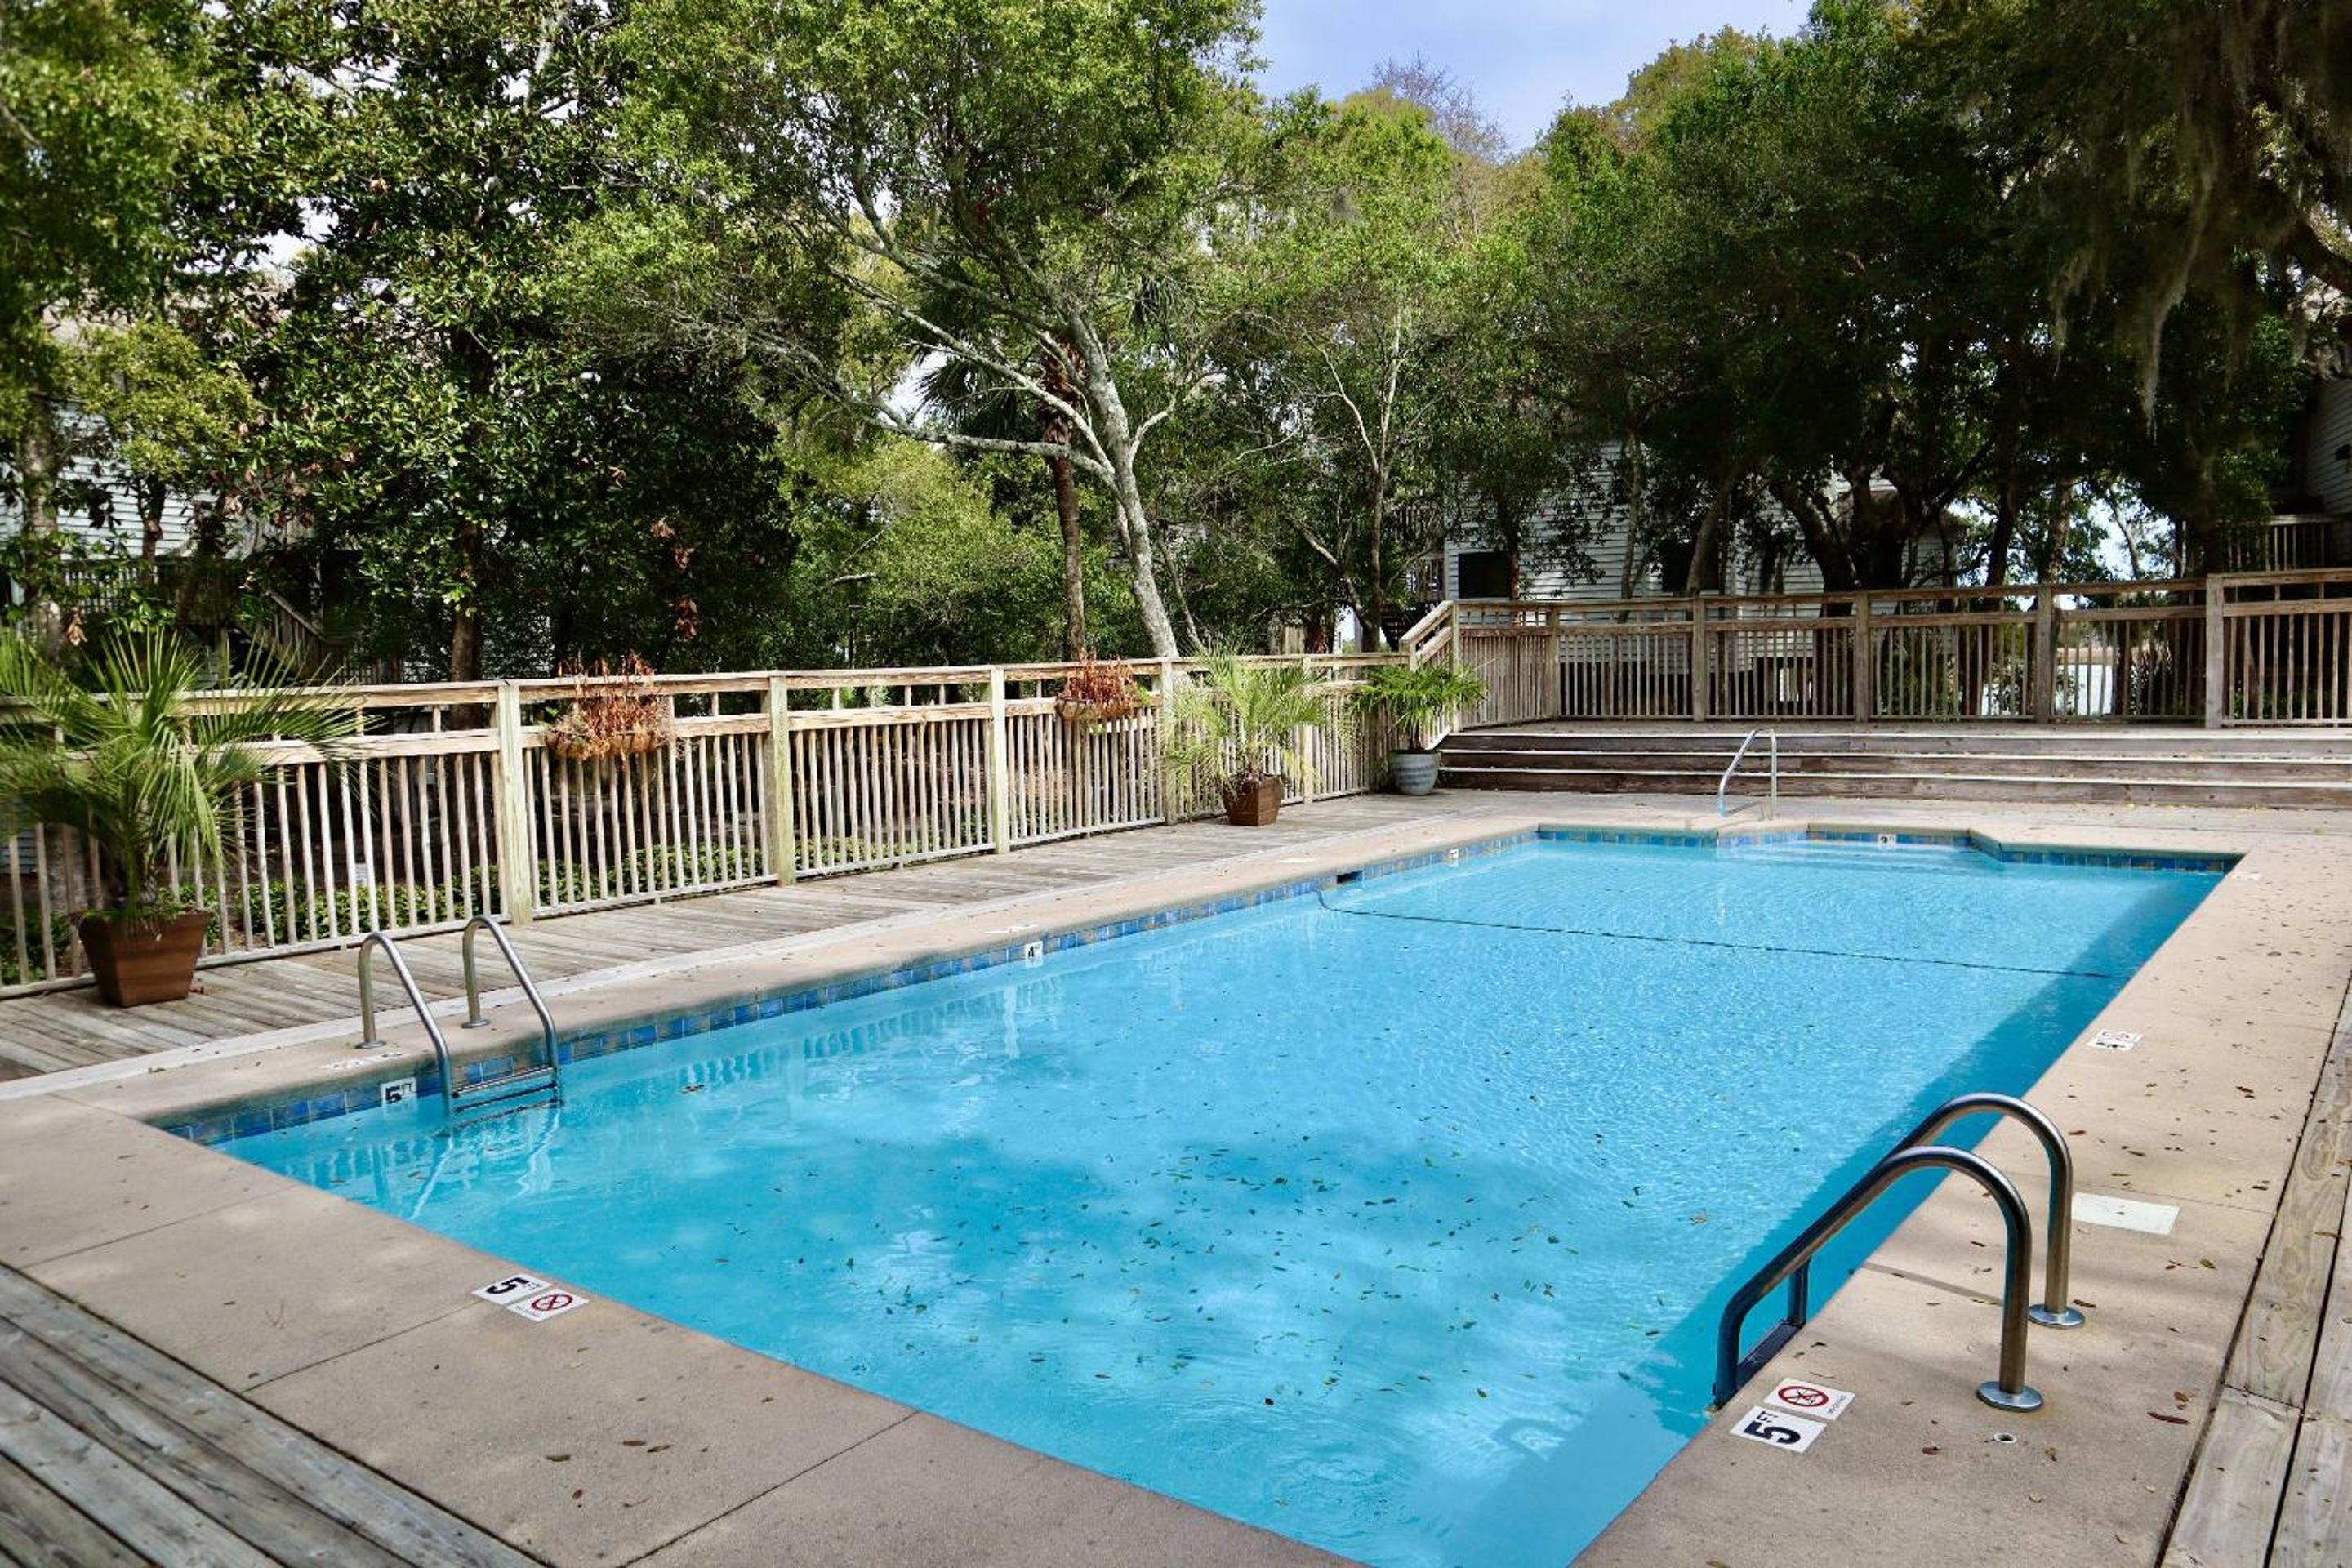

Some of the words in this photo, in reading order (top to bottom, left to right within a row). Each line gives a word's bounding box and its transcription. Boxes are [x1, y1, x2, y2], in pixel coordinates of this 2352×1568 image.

[385, 1085, 402, 1104] 5
[486, 1276, 529, 1294] 5
[1743, 1420, 1802, 1445] 5
